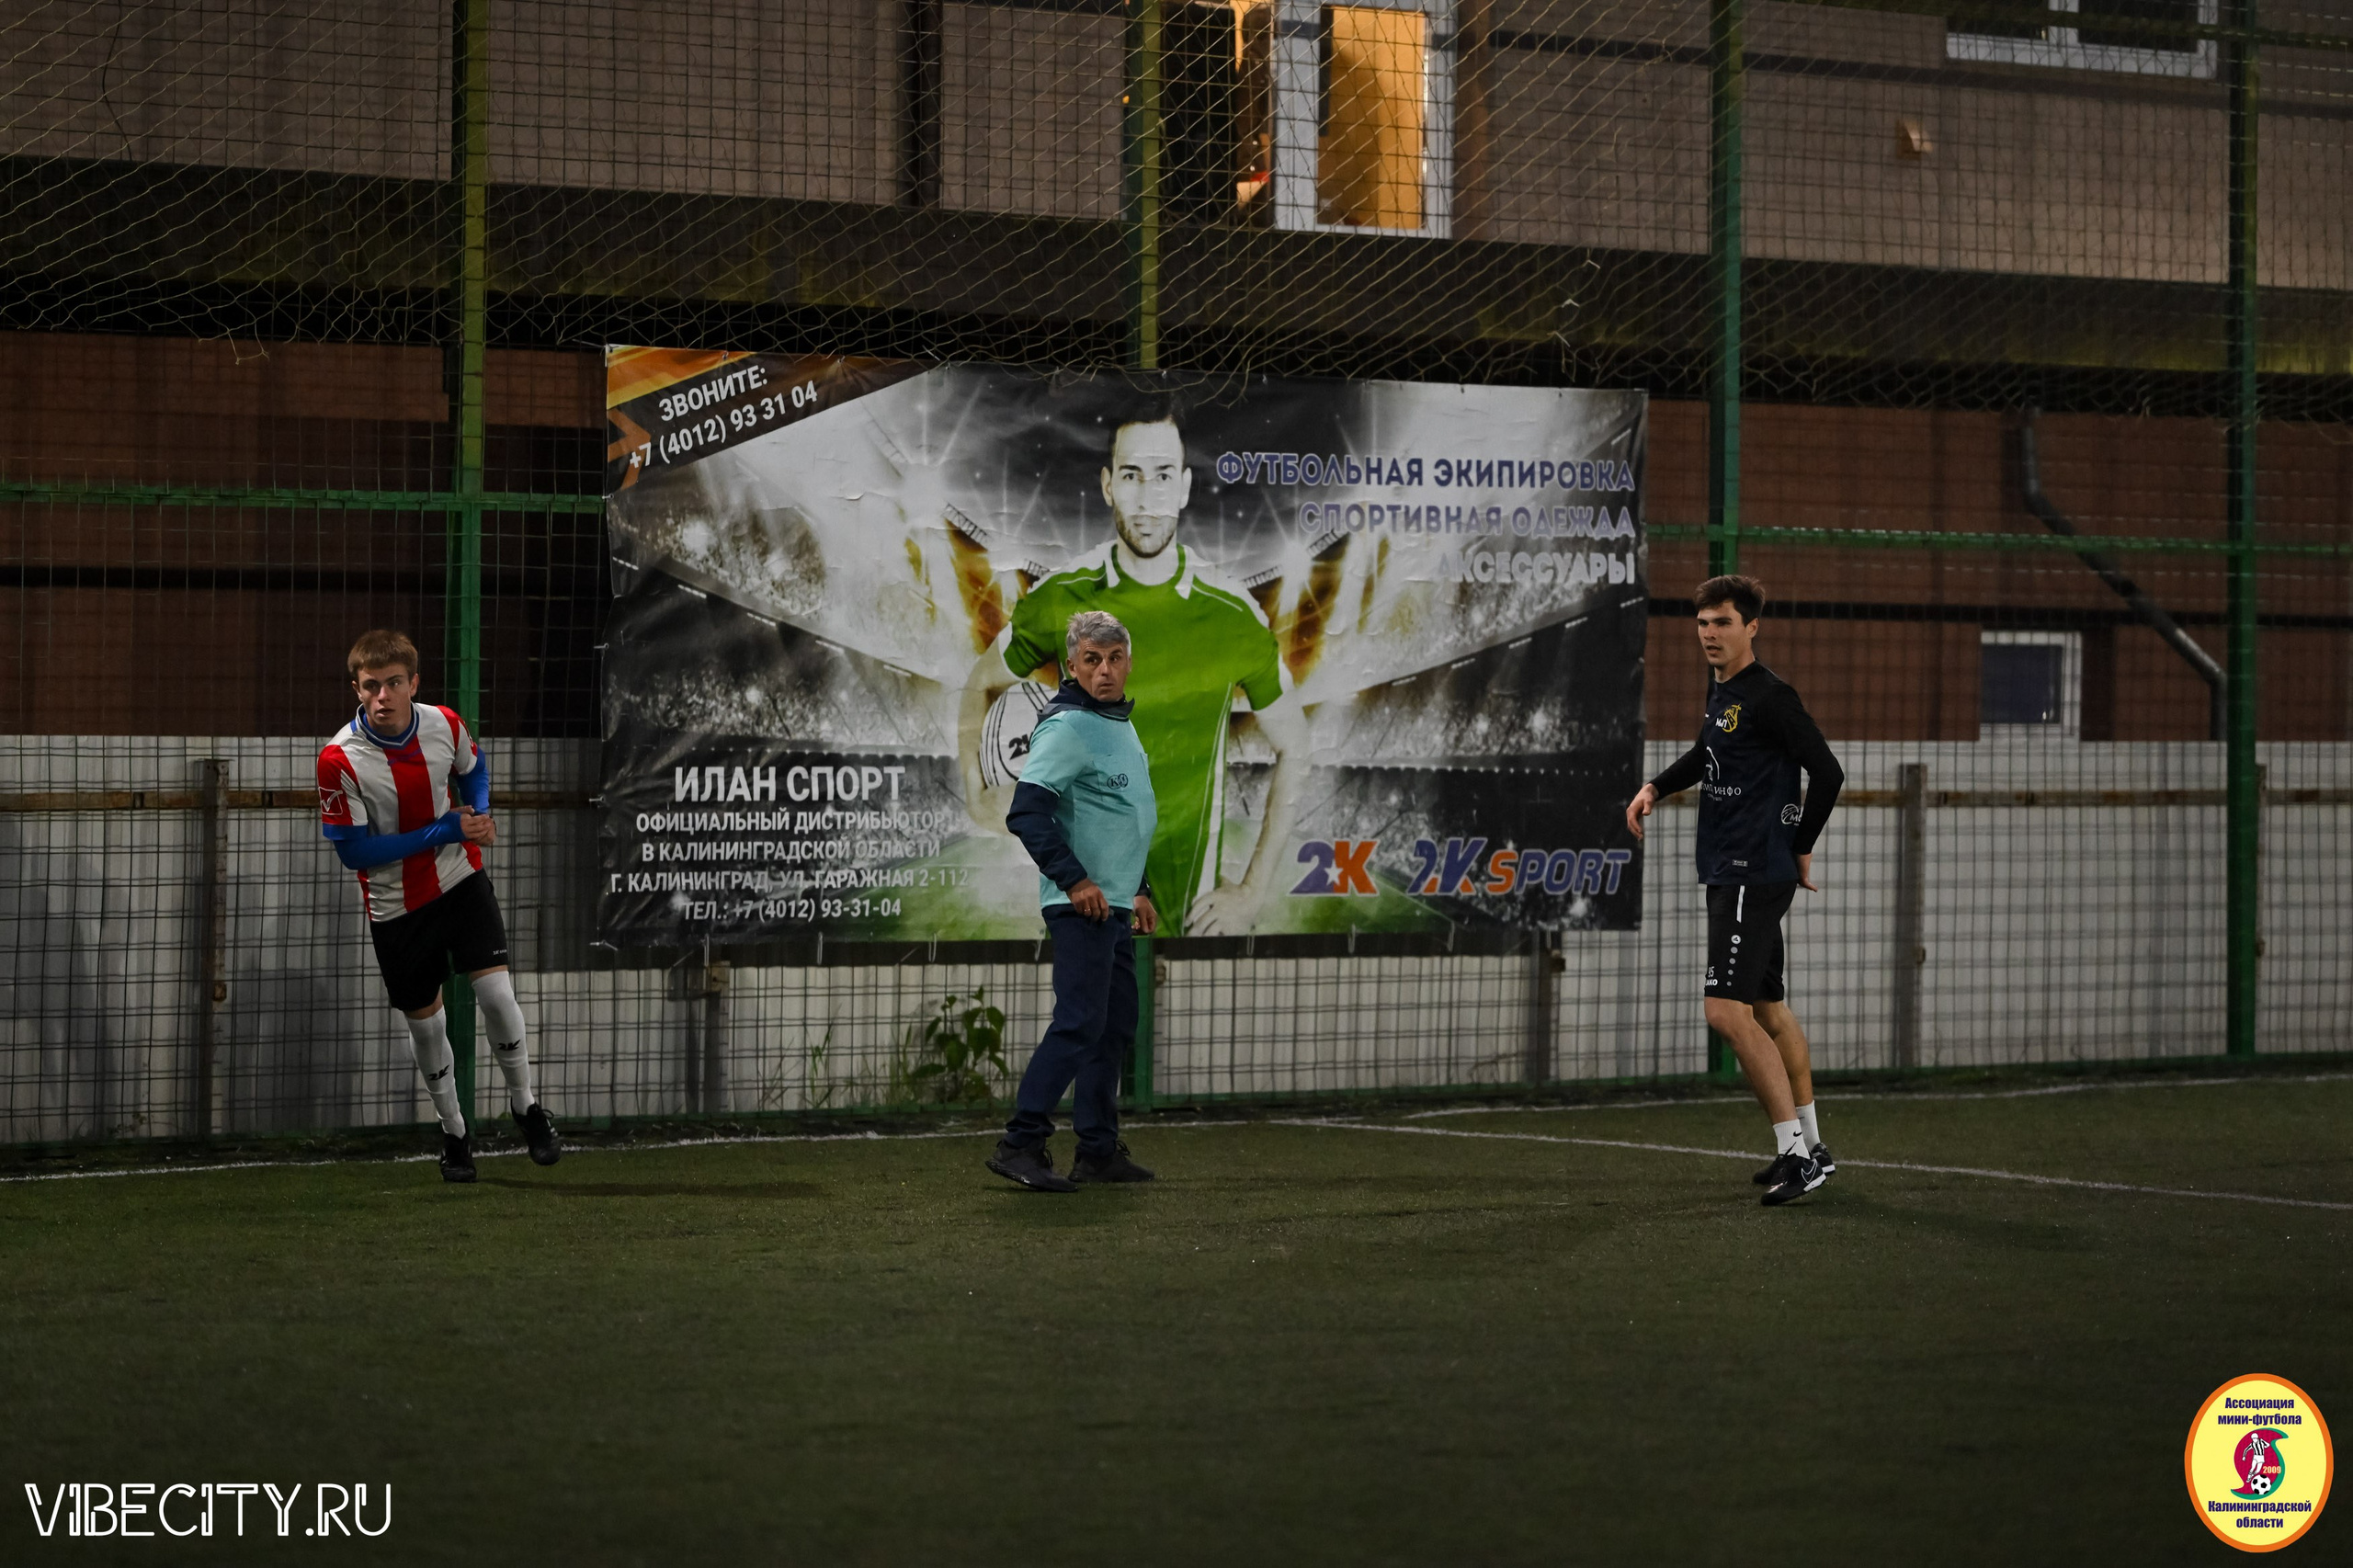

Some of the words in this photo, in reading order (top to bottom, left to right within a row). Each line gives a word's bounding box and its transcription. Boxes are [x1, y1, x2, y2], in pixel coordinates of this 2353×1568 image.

[658, 365, 768, 422] ЗВОНИТЕ:
[629, 442, 652, 470] +7
[659, 414, 727, 464] (4012)
[730, 403, 757, 432] 93
[760, 393, 787, 421] 31
[791, 381, 818, 410] 04
[1216, 450, 1424, 487] ФУТБОЛЬНАЯ
[1433, 458, 1635, 492] ЭКИПИРОВКА
[1299, 501, 1503, 536] СПОРТИВНАЯ
[1511, 506, 1635, 540] ОДЕЖДА
[1438, 551, 1635, 585] АКСЕССУАРЫ
[675, 767, 777, 802] ИЛАН
[786, 766, 906, 802] СПОРТ
[636, 807, 790, 835] ОФИЦИАЛЬНЫЙ
[794, 810, 945, 835] ДИСТРИБЬЮТОР
[642, 843, 654, 862] В
[659, 836, 850, 865] КАЛИНИНГРАДСКОЙ
[856, 839, 940, 859] ОБЛАСТИ
[1289, 840, 1378, 896] 2K
[1407, 837, 1487, 896] 2K
[1485, 848, 1631, 896] SPORT
[611, 873, 622, 893] Г.
[628, 870, 774, 893] КАЛИНИНГРАД,
[780, 870, 807, 890] УЛ.
[814, 869, 914, 890] ГАРАЖНАЯ
[919, 869, 969, 887] 2-112
[684, 901, 728, 920] ТЕЛ.:
[733, 900, 754, 918] +7
[758, 899, 815, 922] (4012)
[821, 898, 902, 918] 93-31-04
